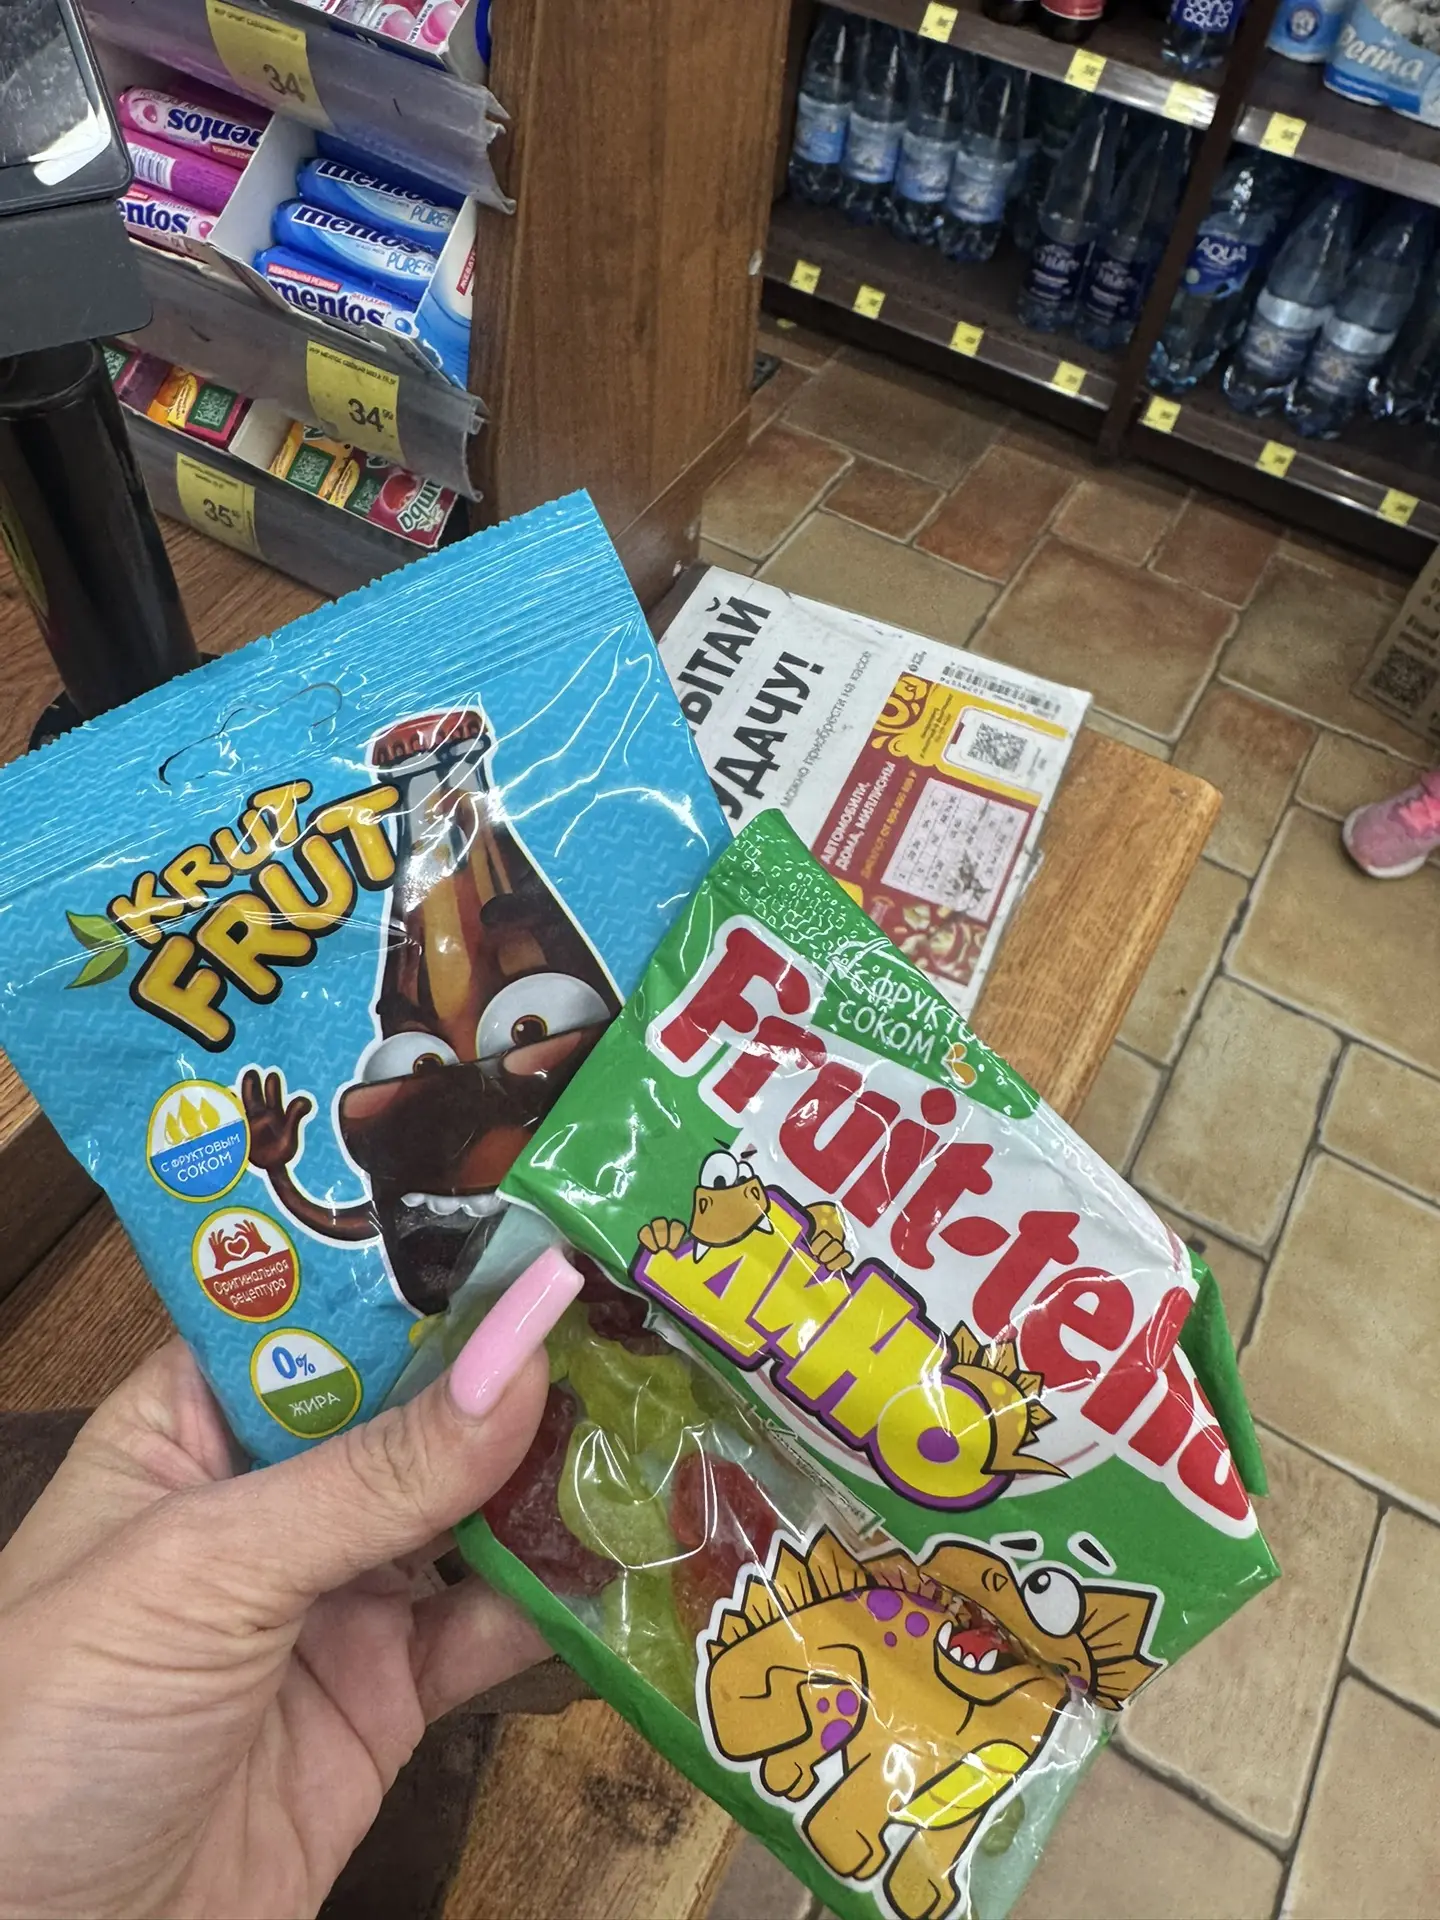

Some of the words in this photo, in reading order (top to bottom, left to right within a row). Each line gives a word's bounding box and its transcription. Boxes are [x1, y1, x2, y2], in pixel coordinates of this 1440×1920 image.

[263, 63, 306, 103] 34
[1196, 237, 1248, 266] AQUA
[268, 280, 387, 327] mentos
[347, 397, 385, 433] 34
[202, 498, 235, 529] 35
[677, 596, 772, 737] ЫТАЙ
[780, 766, 810, 809] можно
[802, 694, 850, 771] приобрести
[841, 679, 857, 699] на
[850, 649, 873, 683] кассе
[819, 780, 873, 866] АВТОМОБИЛИ,
[834, 827, 866, 873] ДОМА,
[855, 760, 897, 830] МИЛЛИОНЫ
[108, 779, 312, 945] KRUT
[130, 783, 401, 1053] FRUT
[837, 999, 937, 1065] СОКОМ
[160, 1162, 170, 1173] С
[171, 1133, 241, 1168] ФРУКТОВЫМ
[177, 1151, 233, 1182] СОКОМ
[213, 1258, 290, 1296] Оригинальная
[229, 1277, 287, 1310] рецептура
[271, 1345, 317, 1380] 0%
[640, 1190, 1000, 1502] ДИНО
[287, 1391, 341, 1417] ЖИРА
